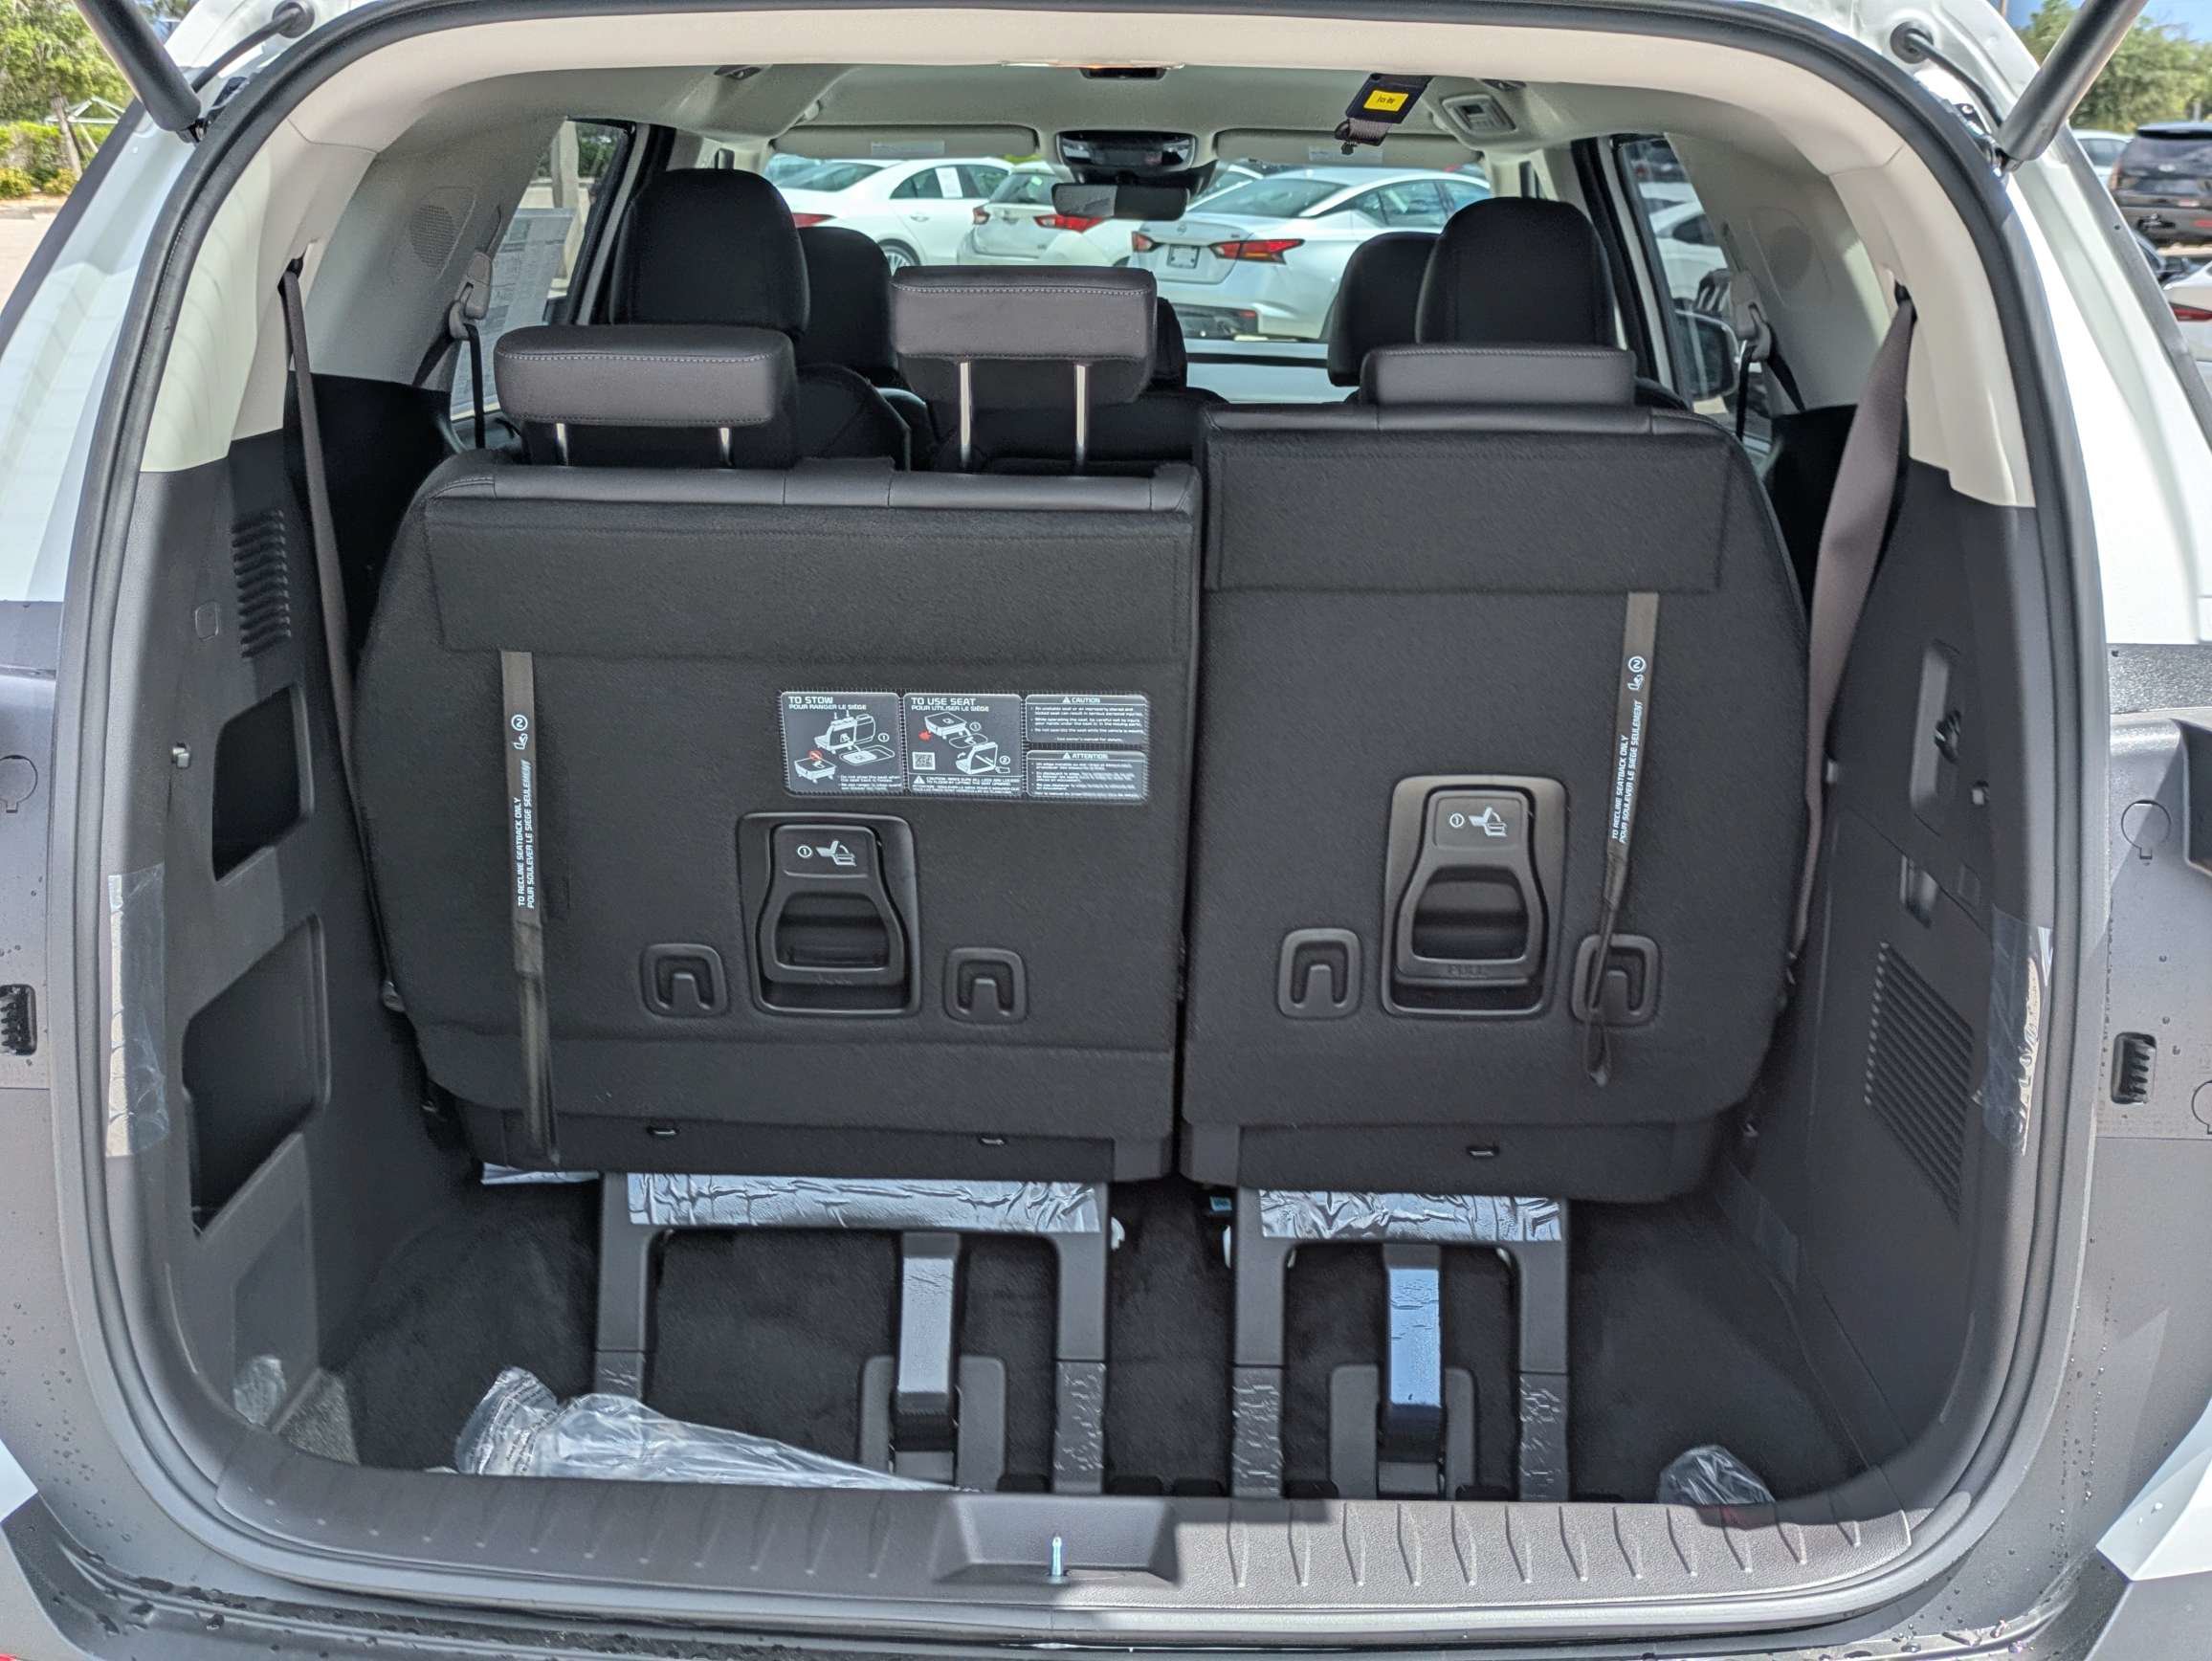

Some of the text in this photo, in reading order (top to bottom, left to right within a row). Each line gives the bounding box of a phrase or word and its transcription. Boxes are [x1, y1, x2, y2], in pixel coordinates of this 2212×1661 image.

[950, 698, 976, 706] SEAT
[1612, 830, 1619, 839] TO
[1619, 734, 1628, 756] ONLY
[514, 797, 522, 819] ONLY
[1619, 822, 1628, 844] POUR
[1626, 770, 1635, 781] LE
[525, 832, 533, 843] LE
[525, 844, 534, 885] SOULEVER
[518, 896, 525, 907] TO
[526, 887, 535, 909] POUR
